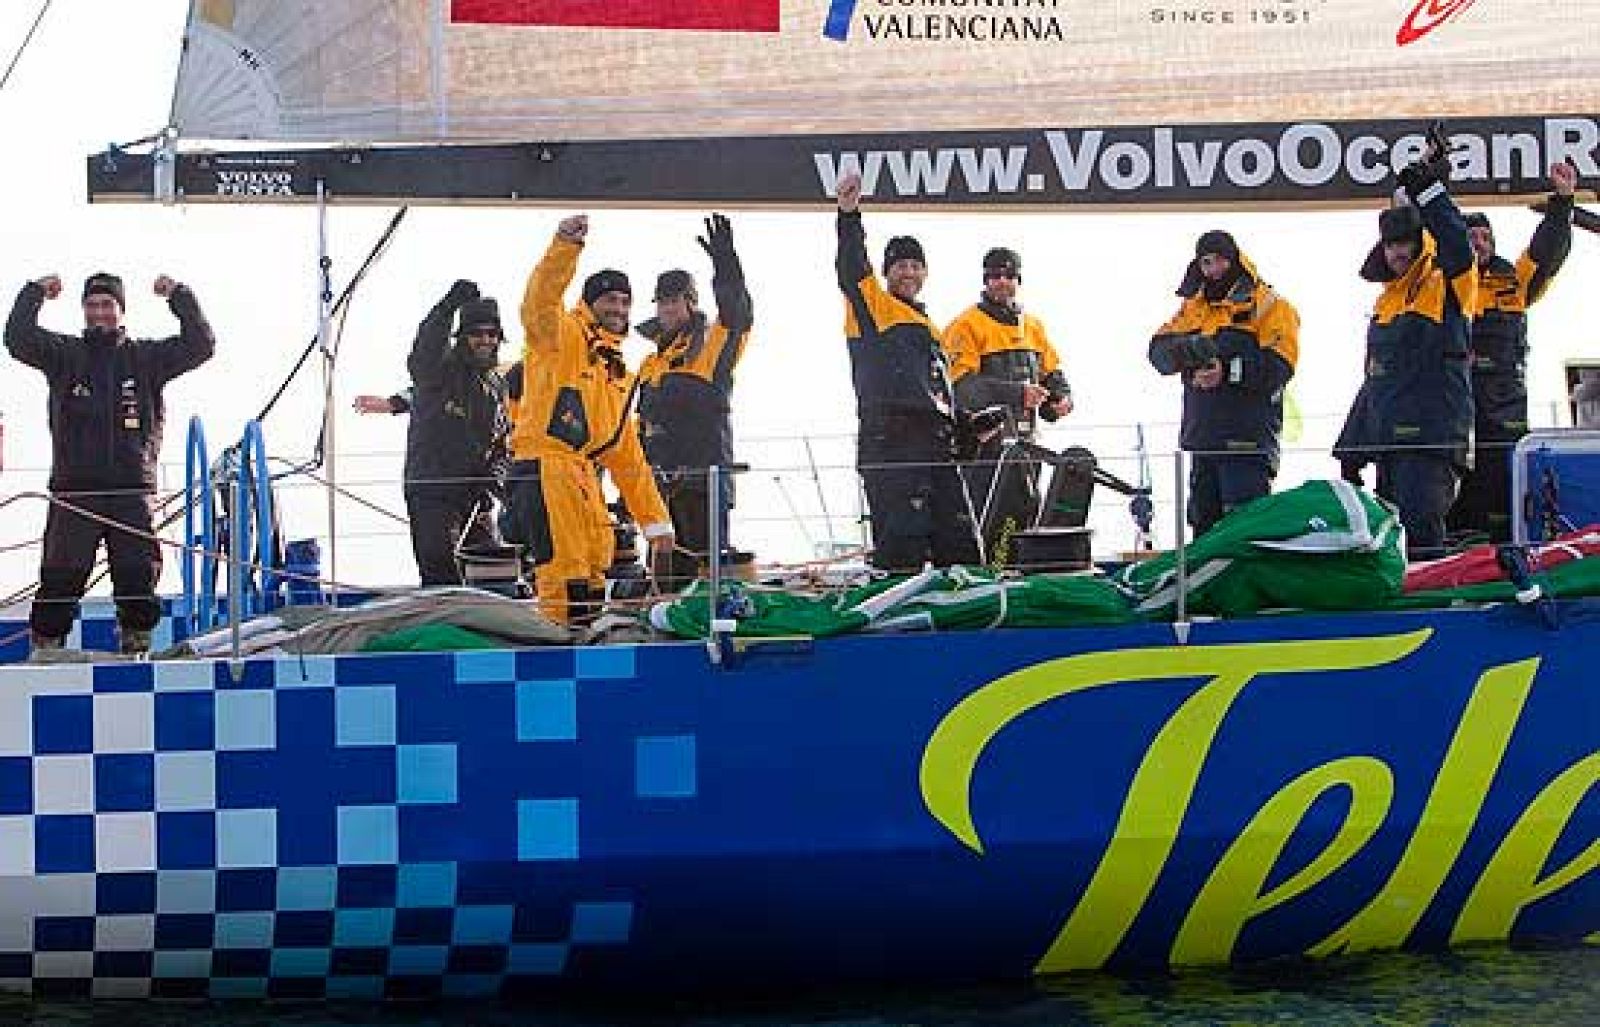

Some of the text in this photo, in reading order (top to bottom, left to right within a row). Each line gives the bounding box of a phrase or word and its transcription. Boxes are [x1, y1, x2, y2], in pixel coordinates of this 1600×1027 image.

[1150, 8, 1311, 24] SINCE 1951
[864, 14, 1064, 41] VALENCIANA
[216, 171, 292, 184] VOLVO
